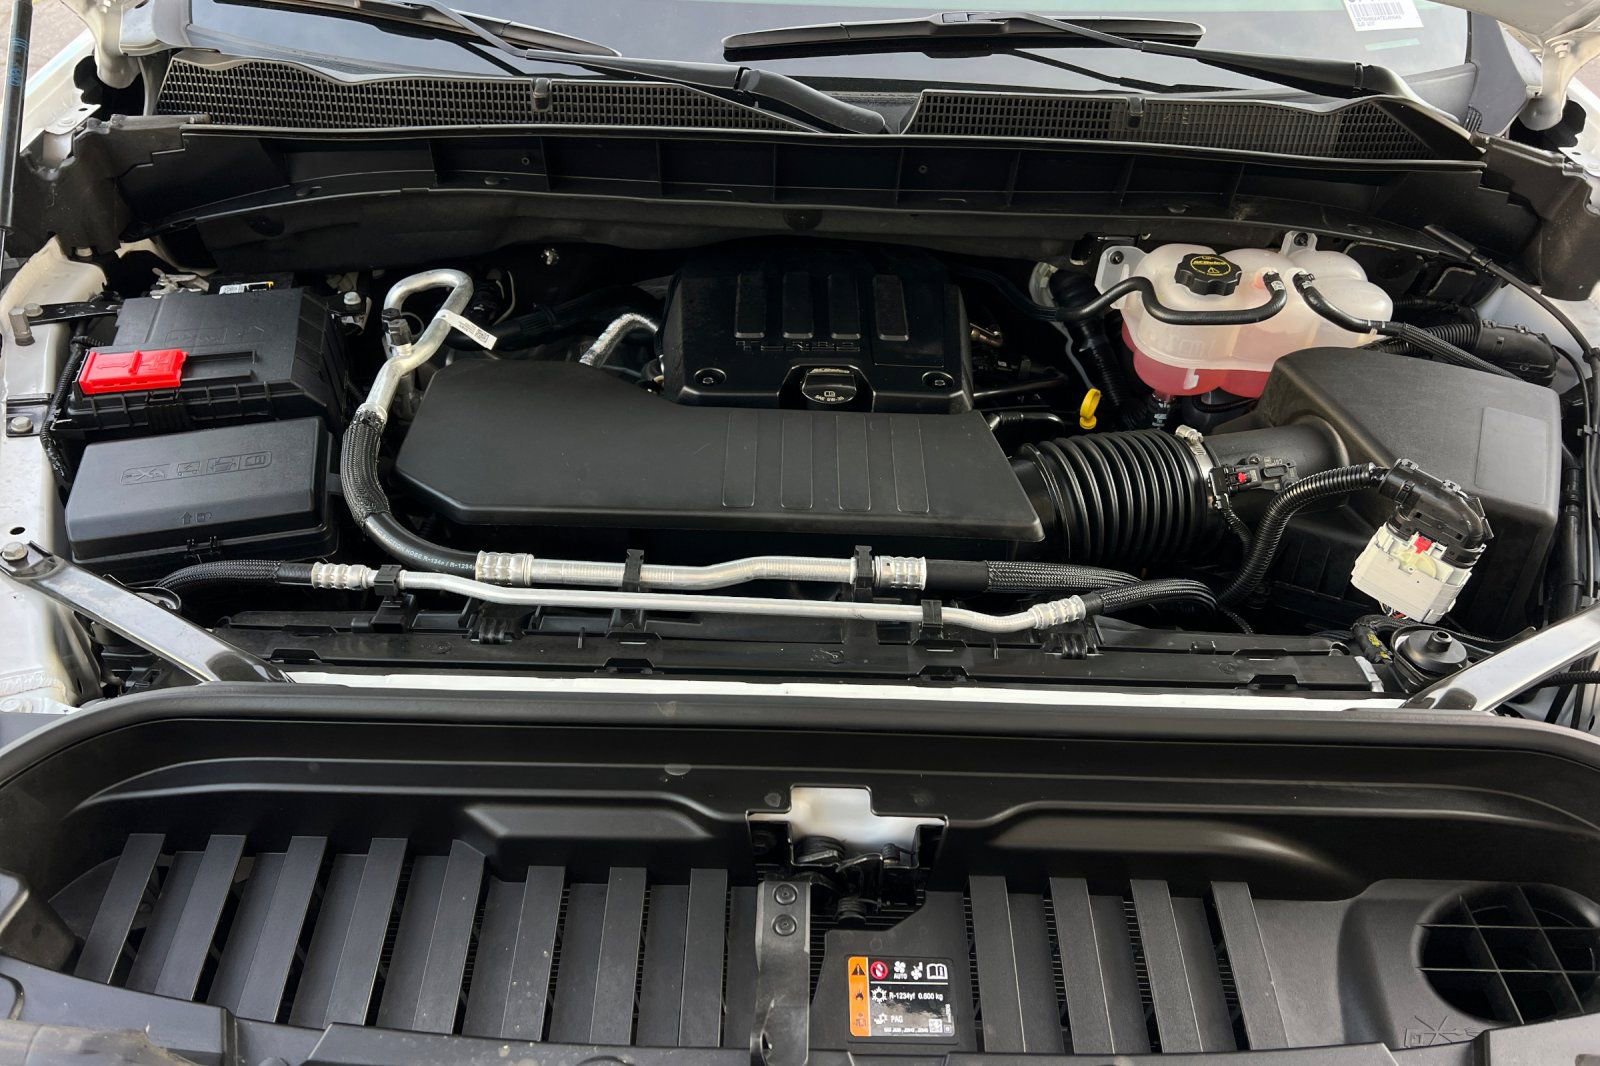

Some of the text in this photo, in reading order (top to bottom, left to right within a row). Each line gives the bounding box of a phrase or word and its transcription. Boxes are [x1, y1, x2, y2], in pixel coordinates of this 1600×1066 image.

[889, 991, 916, 1001] R-1234yf
[935, 993, 944, 1002] kg
[890, 1015, 904, 1023] PAG
